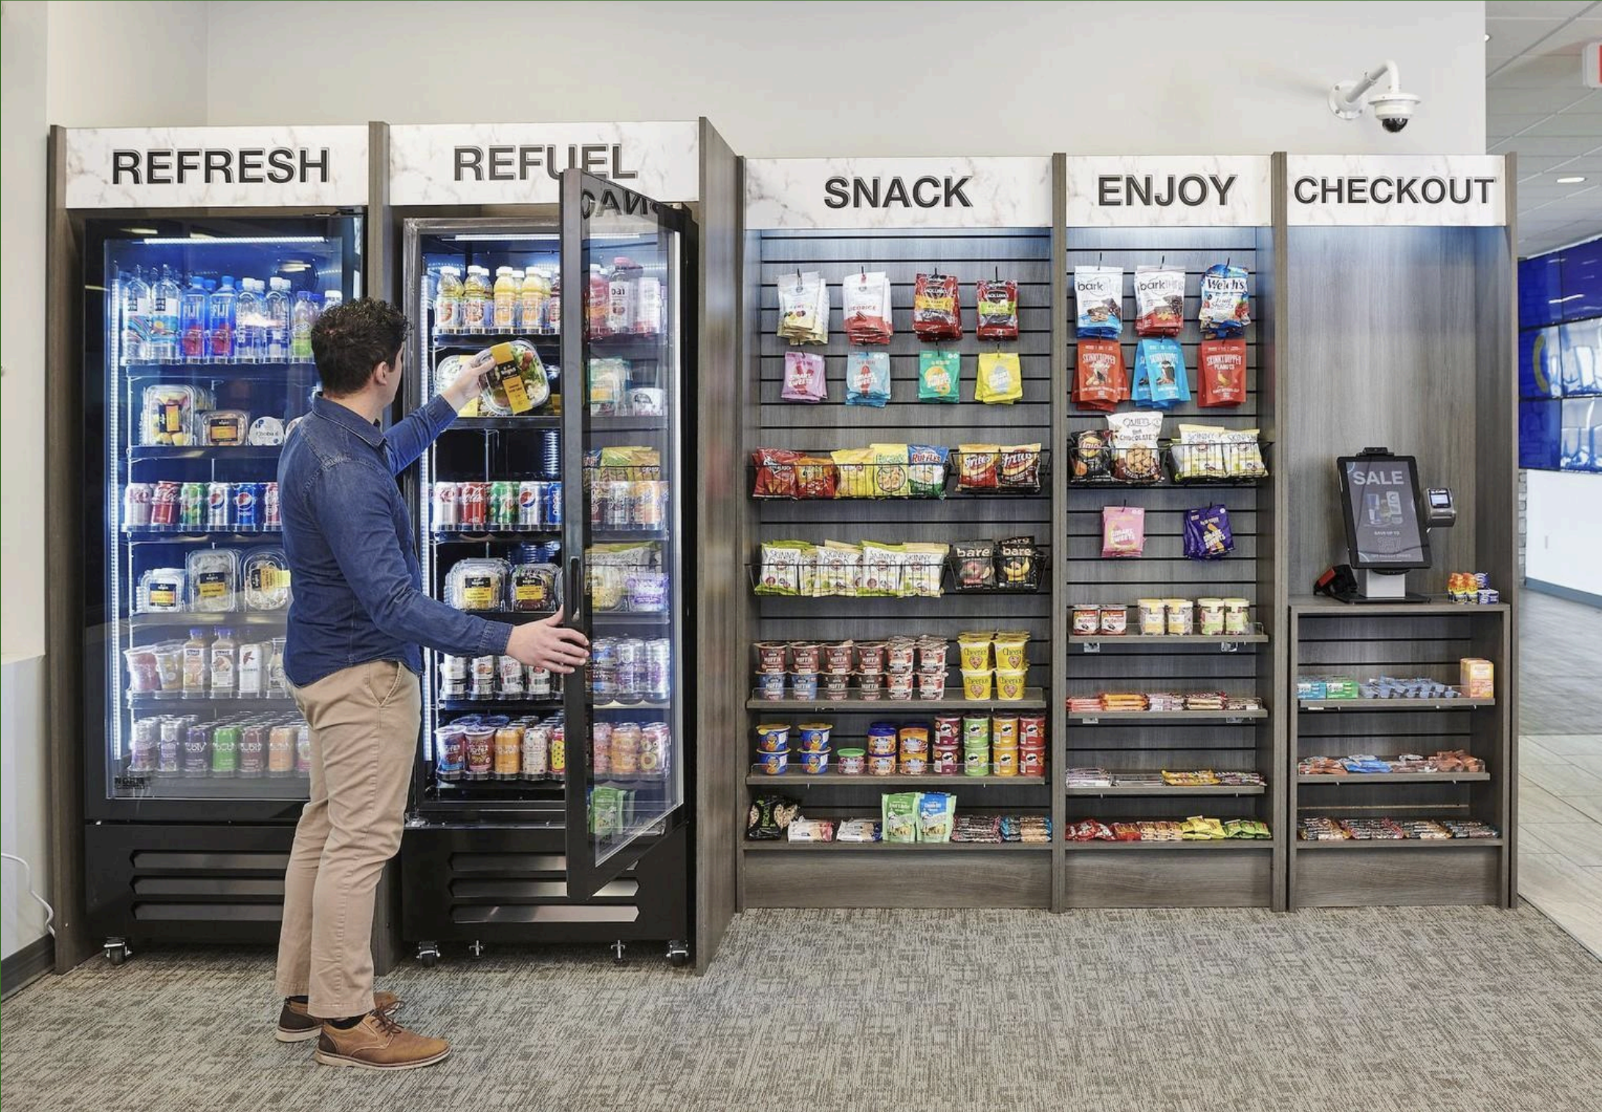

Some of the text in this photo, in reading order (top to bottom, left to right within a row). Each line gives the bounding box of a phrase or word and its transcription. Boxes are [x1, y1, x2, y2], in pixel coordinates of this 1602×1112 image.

[112, 146, 330, 185] REFRESH
[454, 143, 638, 181] REFUEL
[824, 175, 974, 208] SNACK
[1098, 174, 1239, 206] ENJOY
[1294, 175, 1497, 205] CHECKOUT
[1207, 278, 1246, 291] Welch's
[1353, 470, 1405, 485] SALE
[956, 547, 991, 557] bare
[1002, 546, 1032, 556] bare
